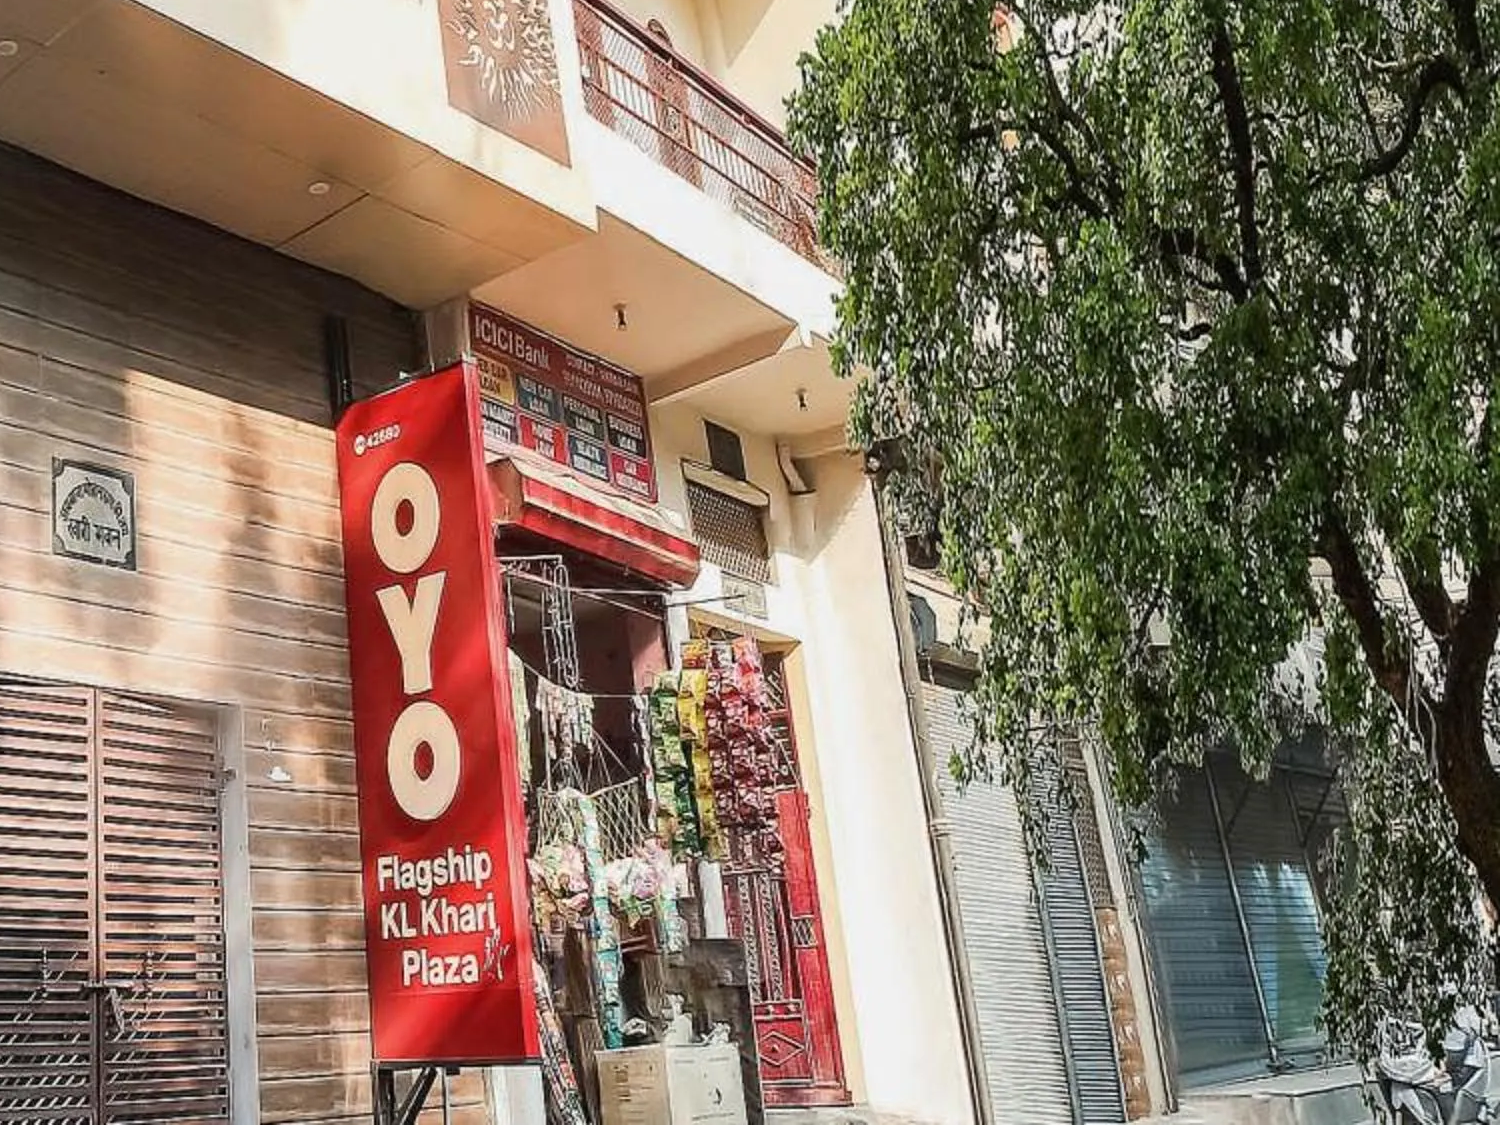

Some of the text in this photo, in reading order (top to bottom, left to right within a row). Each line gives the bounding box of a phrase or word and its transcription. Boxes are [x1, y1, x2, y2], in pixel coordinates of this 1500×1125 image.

[475, 315, 551, 371] ICICI Bank
[371, 461, 461, 822] OYO
[377, 844, 492, 896] Flagship
[381, 892, 497, 940] KL Khari
[403, 949, 480, 987] Plaza
